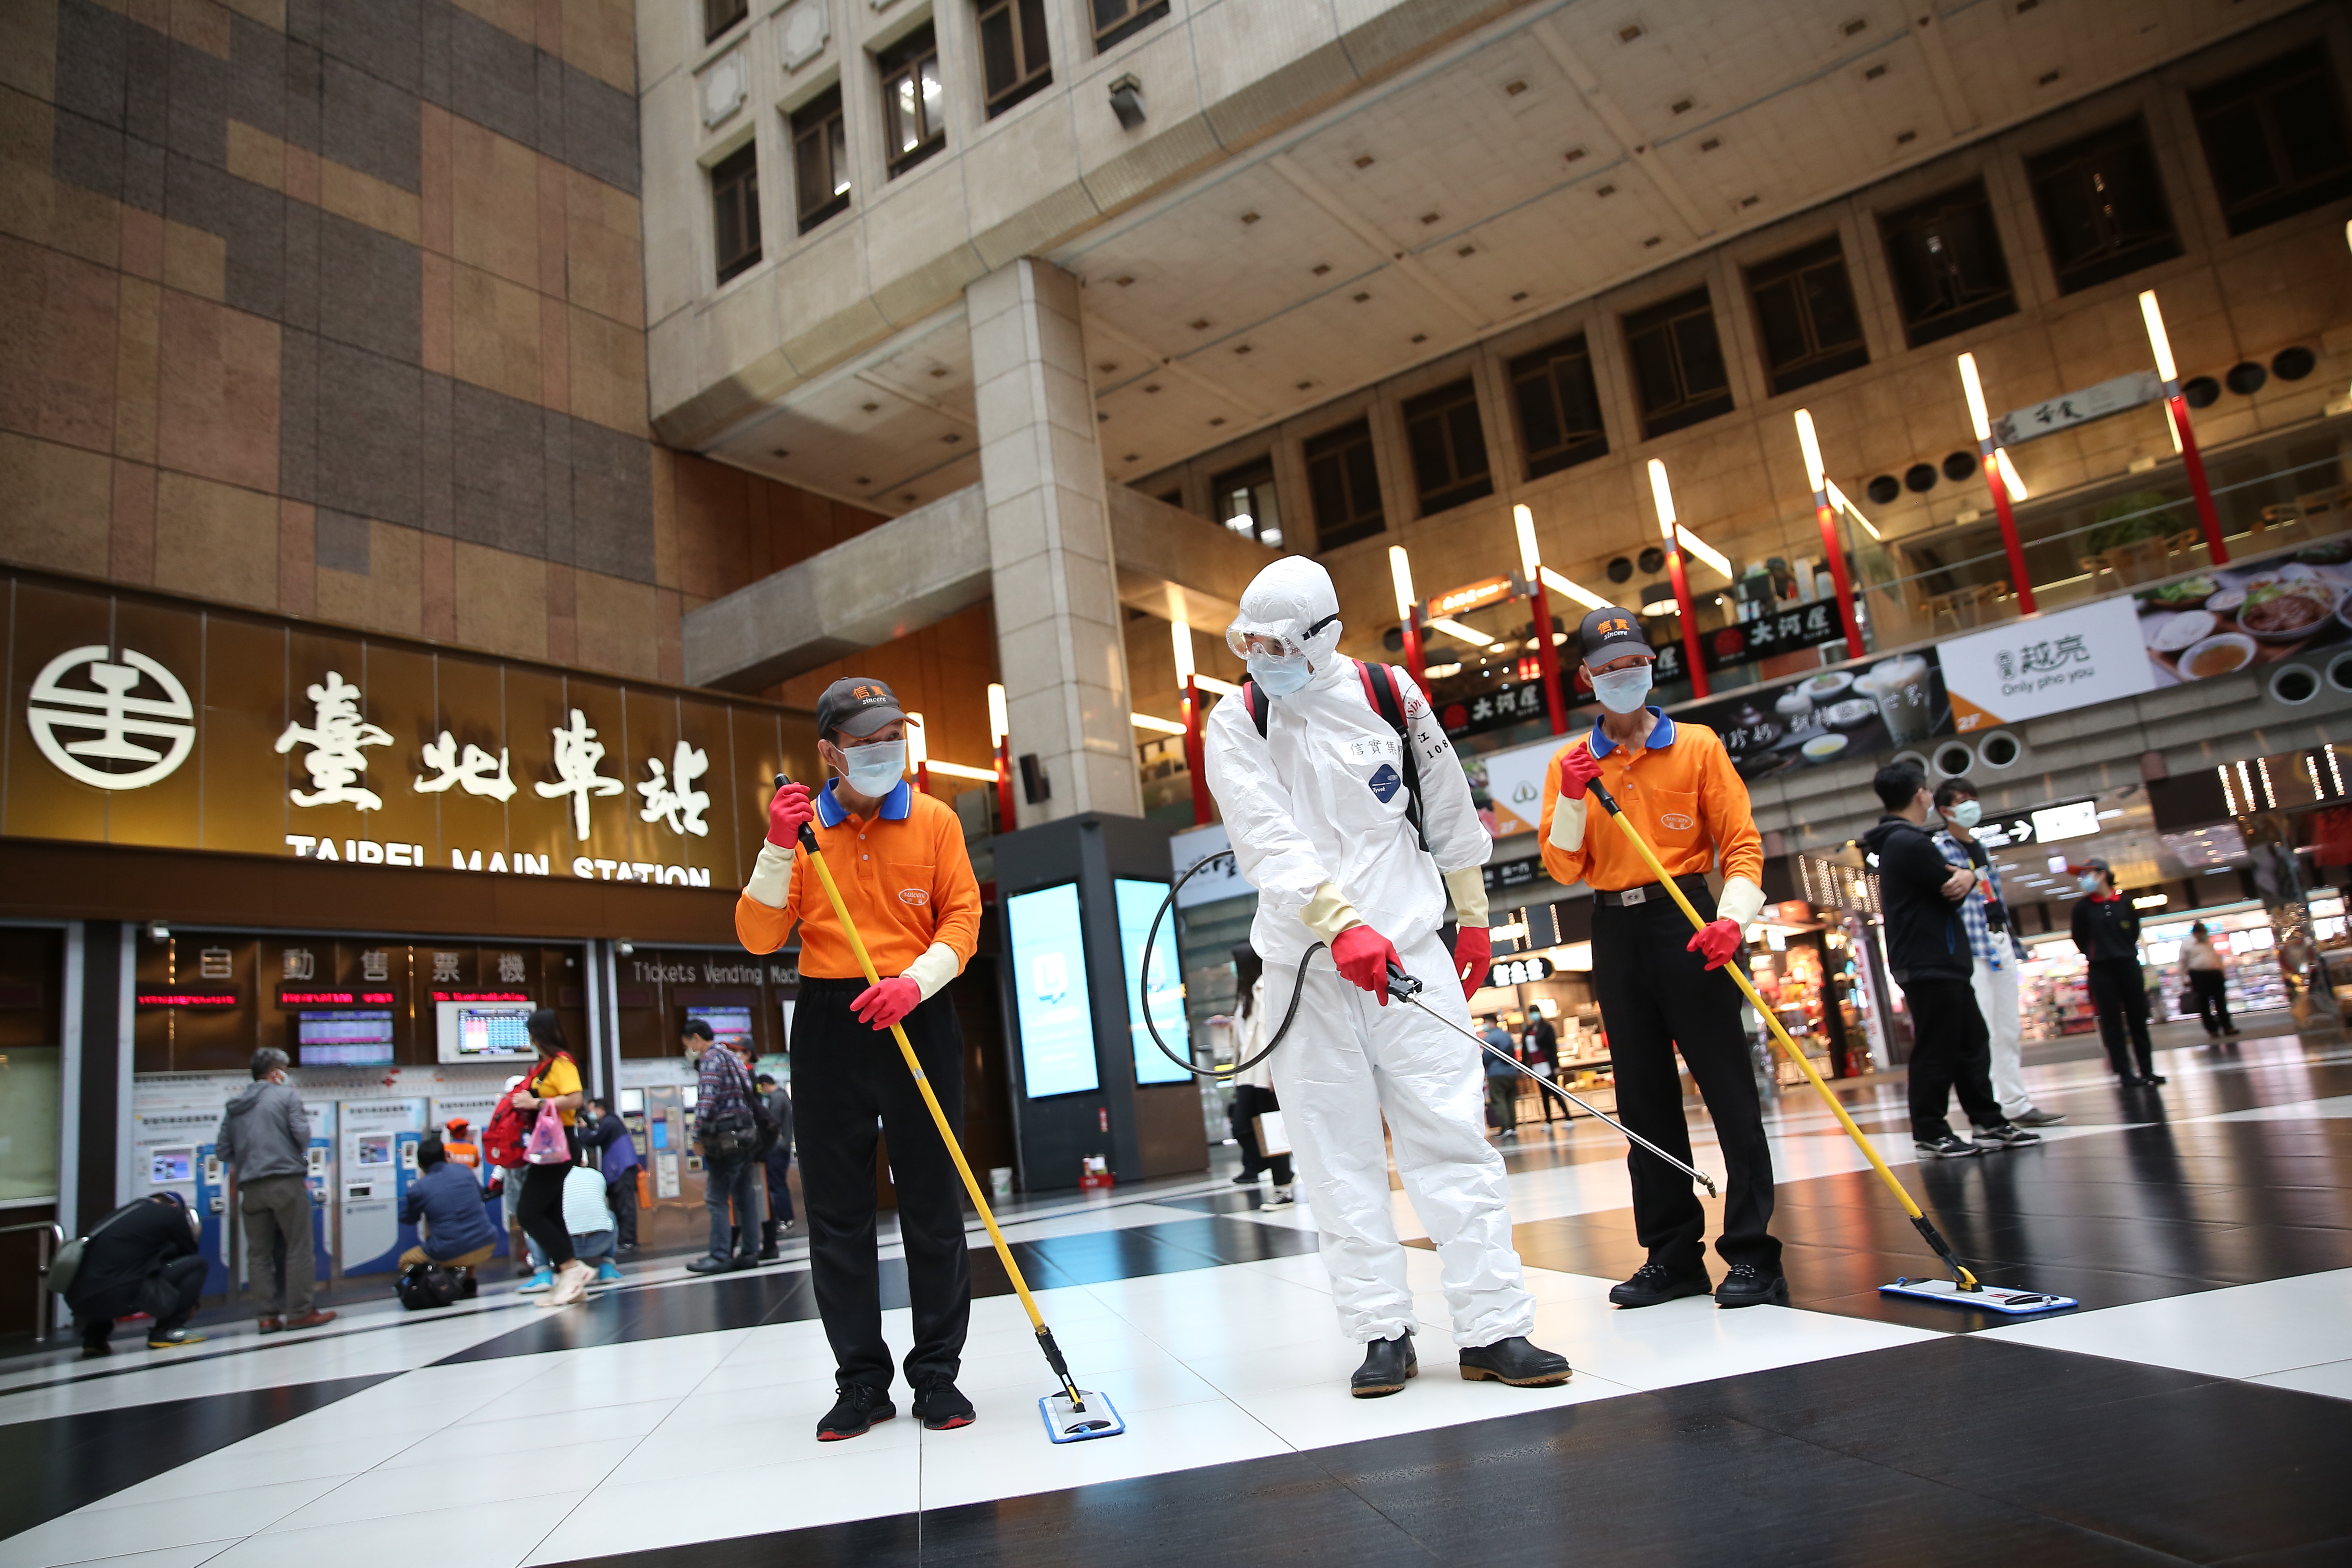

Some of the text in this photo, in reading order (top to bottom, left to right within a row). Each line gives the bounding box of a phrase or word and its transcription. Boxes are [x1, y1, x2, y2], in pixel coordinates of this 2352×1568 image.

[1604, 630, 1628, 640] sincere
[1749, 605, 1829, 646] 大河屋
[2002, 680, 2033, 696] Only
[2068, 666, 2095, 684] you
[862, 697, 886, 705] sincere
[1472, 684, 1540, 721] 大河屋
[1958, 713, 1980, 731] 2F
[275, 671, 710, 842] 臺北車站
[1426, 739, 1449, 759] 108
[200, 946, 526, 983] 自動售票機
[633, 961, 696, 983] Tickets
[702, 963, 763, 986] Vending
